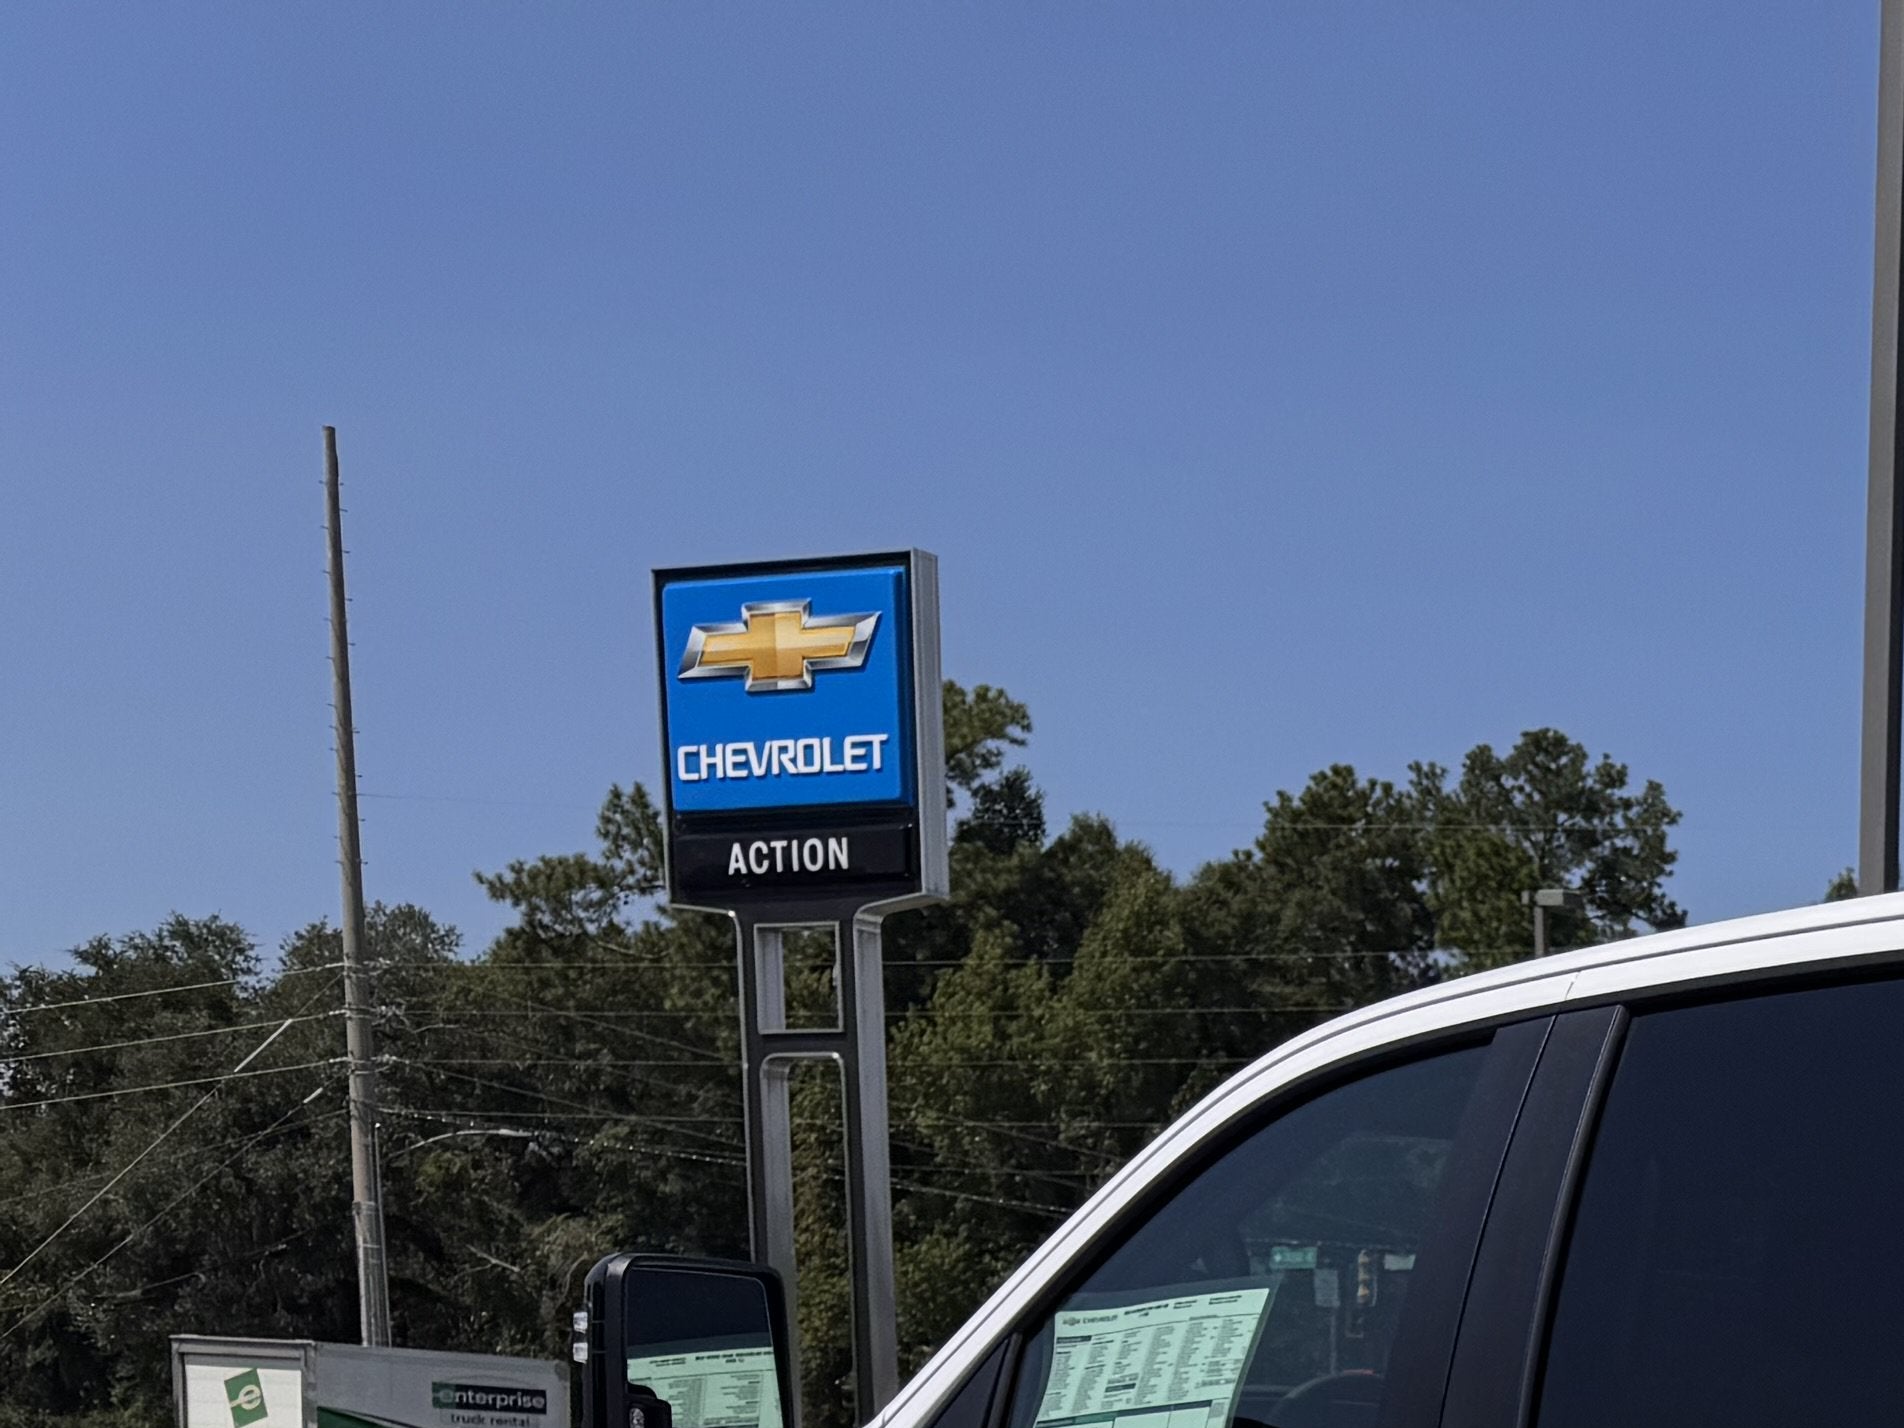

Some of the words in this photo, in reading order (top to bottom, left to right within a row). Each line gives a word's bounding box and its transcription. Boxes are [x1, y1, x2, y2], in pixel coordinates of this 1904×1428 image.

[677, 733, 889, 782] CHEVROLET
[728, 836, 850, 876] ACTION
[438, 1388, 546, 1409] enterprise
[450, 1413, 485, 1425] truck
[489, 1415, 531, 1428] rental
